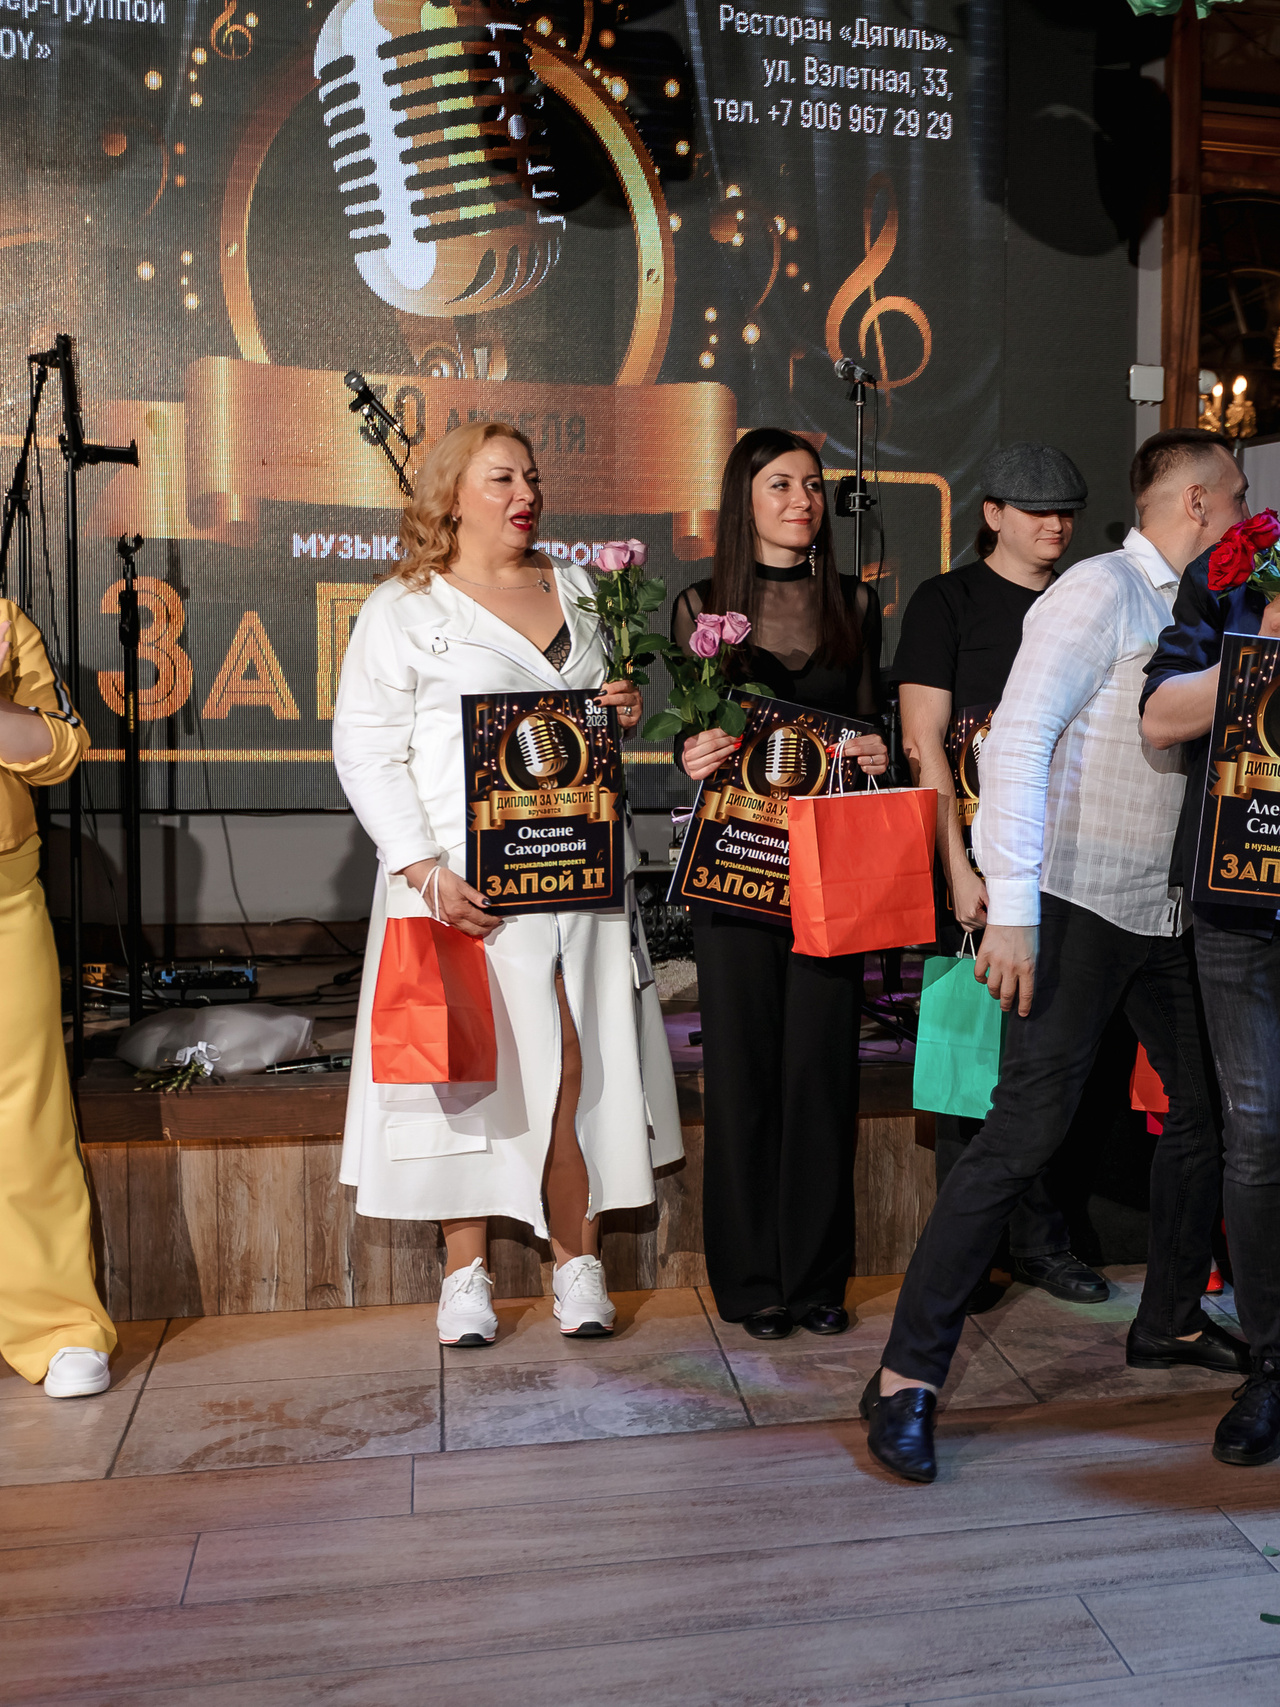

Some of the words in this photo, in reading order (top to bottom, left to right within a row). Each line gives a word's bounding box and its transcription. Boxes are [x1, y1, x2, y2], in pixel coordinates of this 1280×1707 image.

[0, 0, 166, 25] ер-группой
[719, 3, 832, 46] Ресторан
[839, 17, 954, 53] «Дягиль».
[762, 56, 797, 88] ул.
[803, 56, 916, 99] Взлетная,
[921, 67, 954, 102] 33,
[713, 98, 760, 125] тел.
[767, 99, 793, 127] +7
[800, 99, 842, 131] 906
[849, 104, 888, 135] 967
[893, 107, 921, 138] 29
[925, 111, 953, 141] 29
[293, 531, 409, 561] МУЗЫК
[586, 714, 608, 727] 2023
[497, 795, 537, 810] ДИПЛОМ
[540, 794, 552, 806] ЗА
[554, 791, 594, 805] УЧАСТИЕ
[726, 793, 766, 812] ДИПЛОМ
[766, 802, 778, 815] ЗА
[528, 808, 561, 817] вручается
[752, 813, 784, 825] вручается
[518, 826, 574, 840] Оксане
[504, 839, 587, 857] Сахоровой
[510, 860, 558, 871] музыкальном
[559, 858, 586, 867] проекте
[720, 860, 764, 875] музыкальном
[582, 867, 605, 890] II
